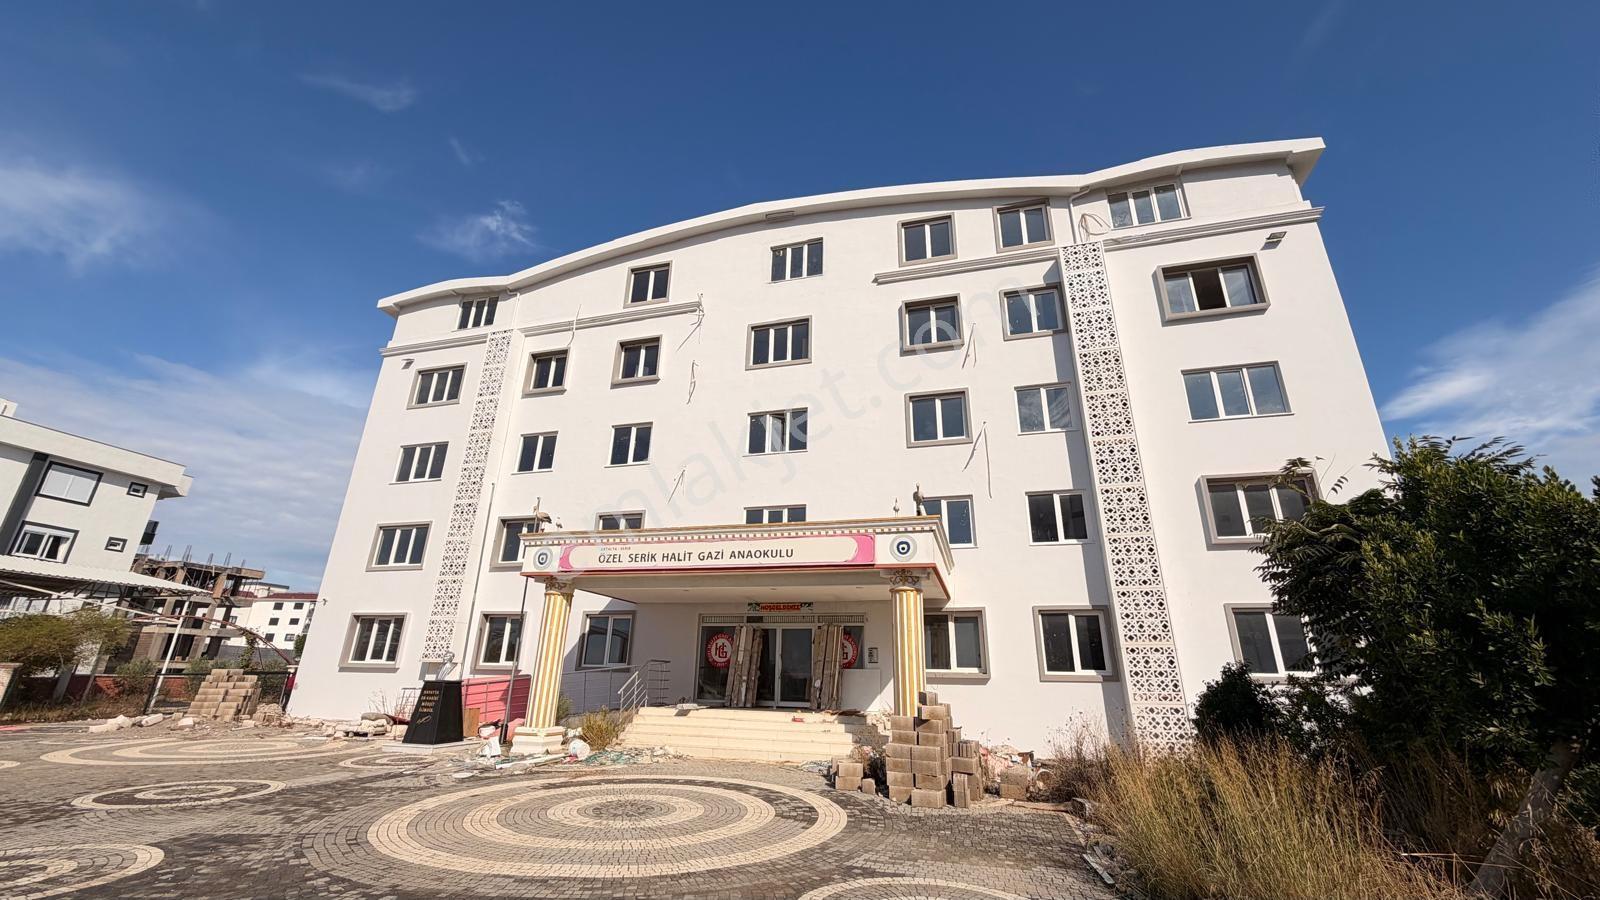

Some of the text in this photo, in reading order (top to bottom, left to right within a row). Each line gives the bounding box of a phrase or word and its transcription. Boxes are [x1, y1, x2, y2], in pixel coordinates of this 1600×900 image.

[598, 548, 794, 564] ÖZEL SERİK HALİT GAZİ ANAOKULU
